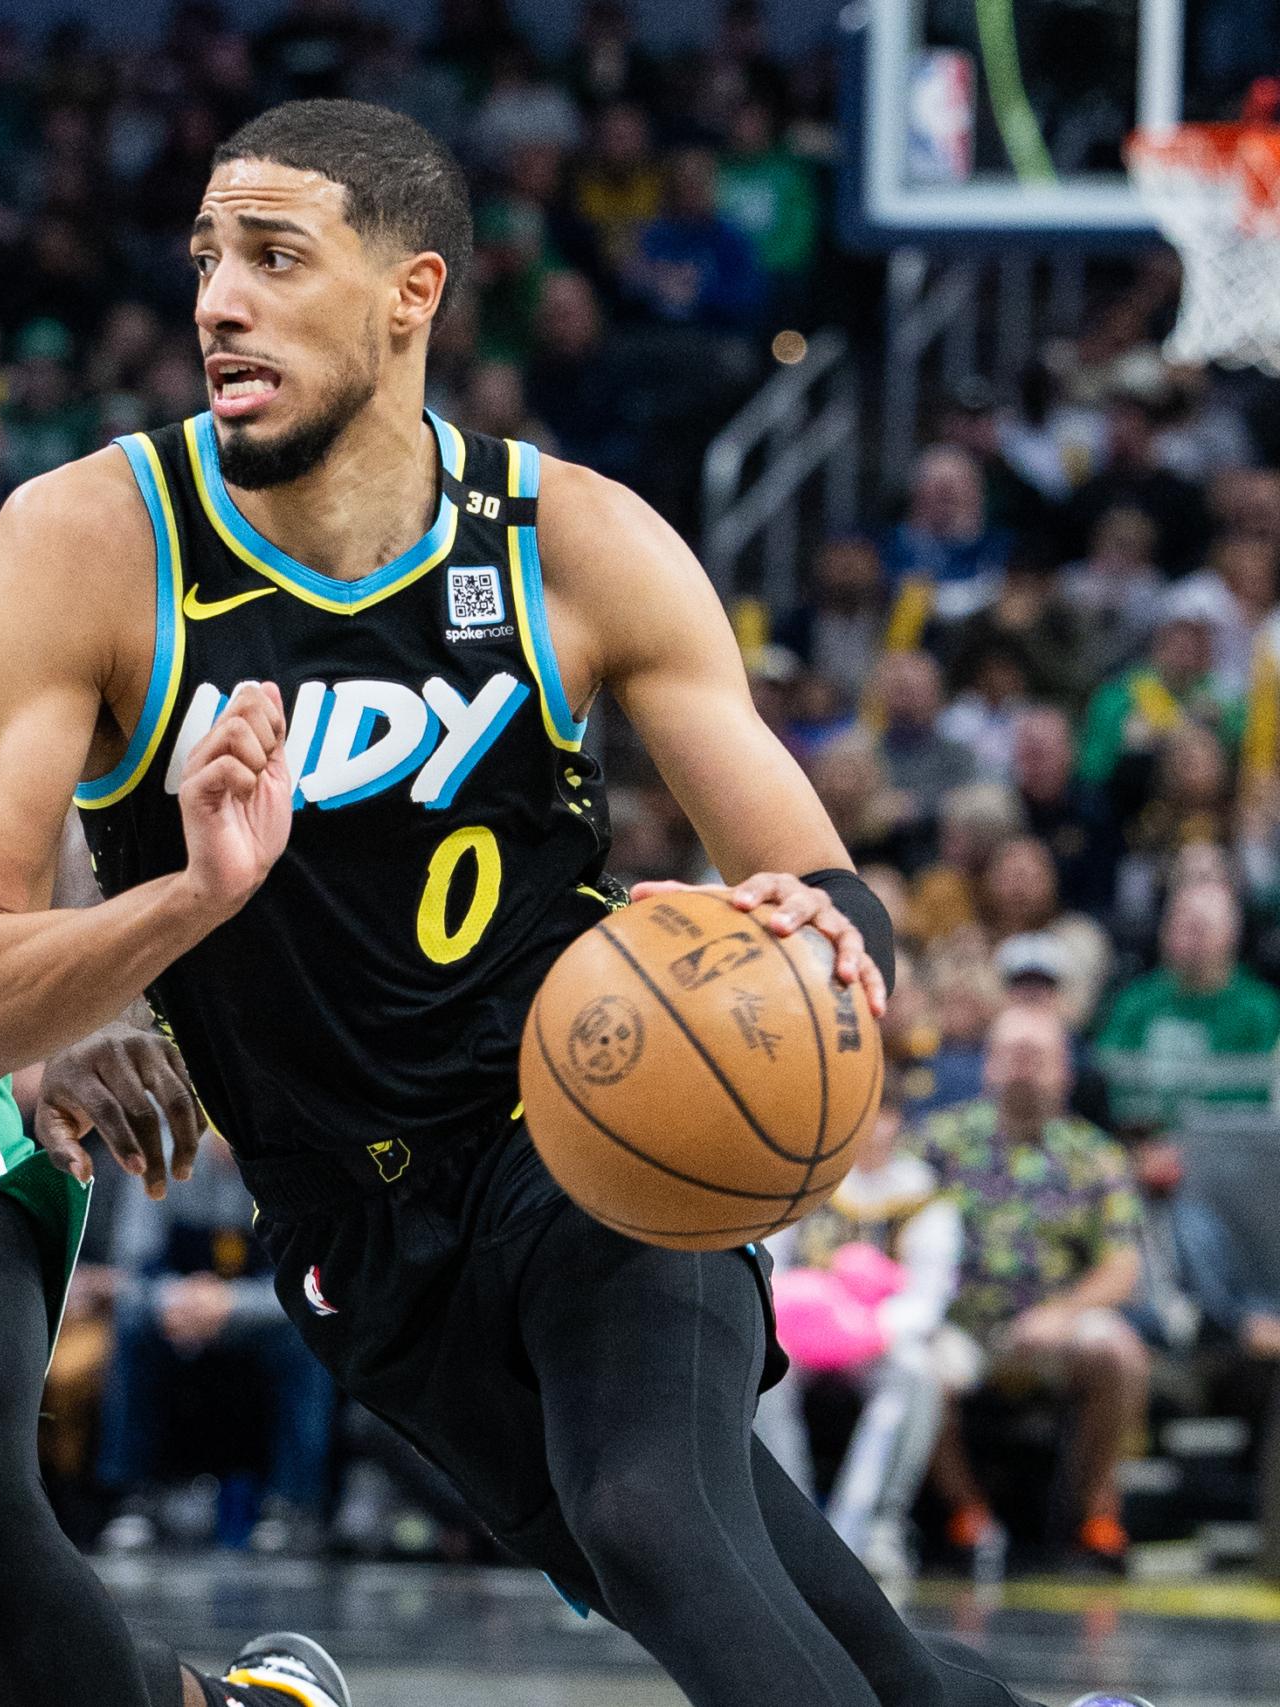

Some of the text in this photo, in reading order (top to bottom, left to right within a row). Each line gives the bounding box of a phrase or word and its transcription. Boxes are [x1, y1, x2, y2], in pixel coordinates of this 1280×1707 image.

[465, 490, 501, 520] 30
[445, 625, 514, 643] spokenote
[417, 825, 502, 965] 0
